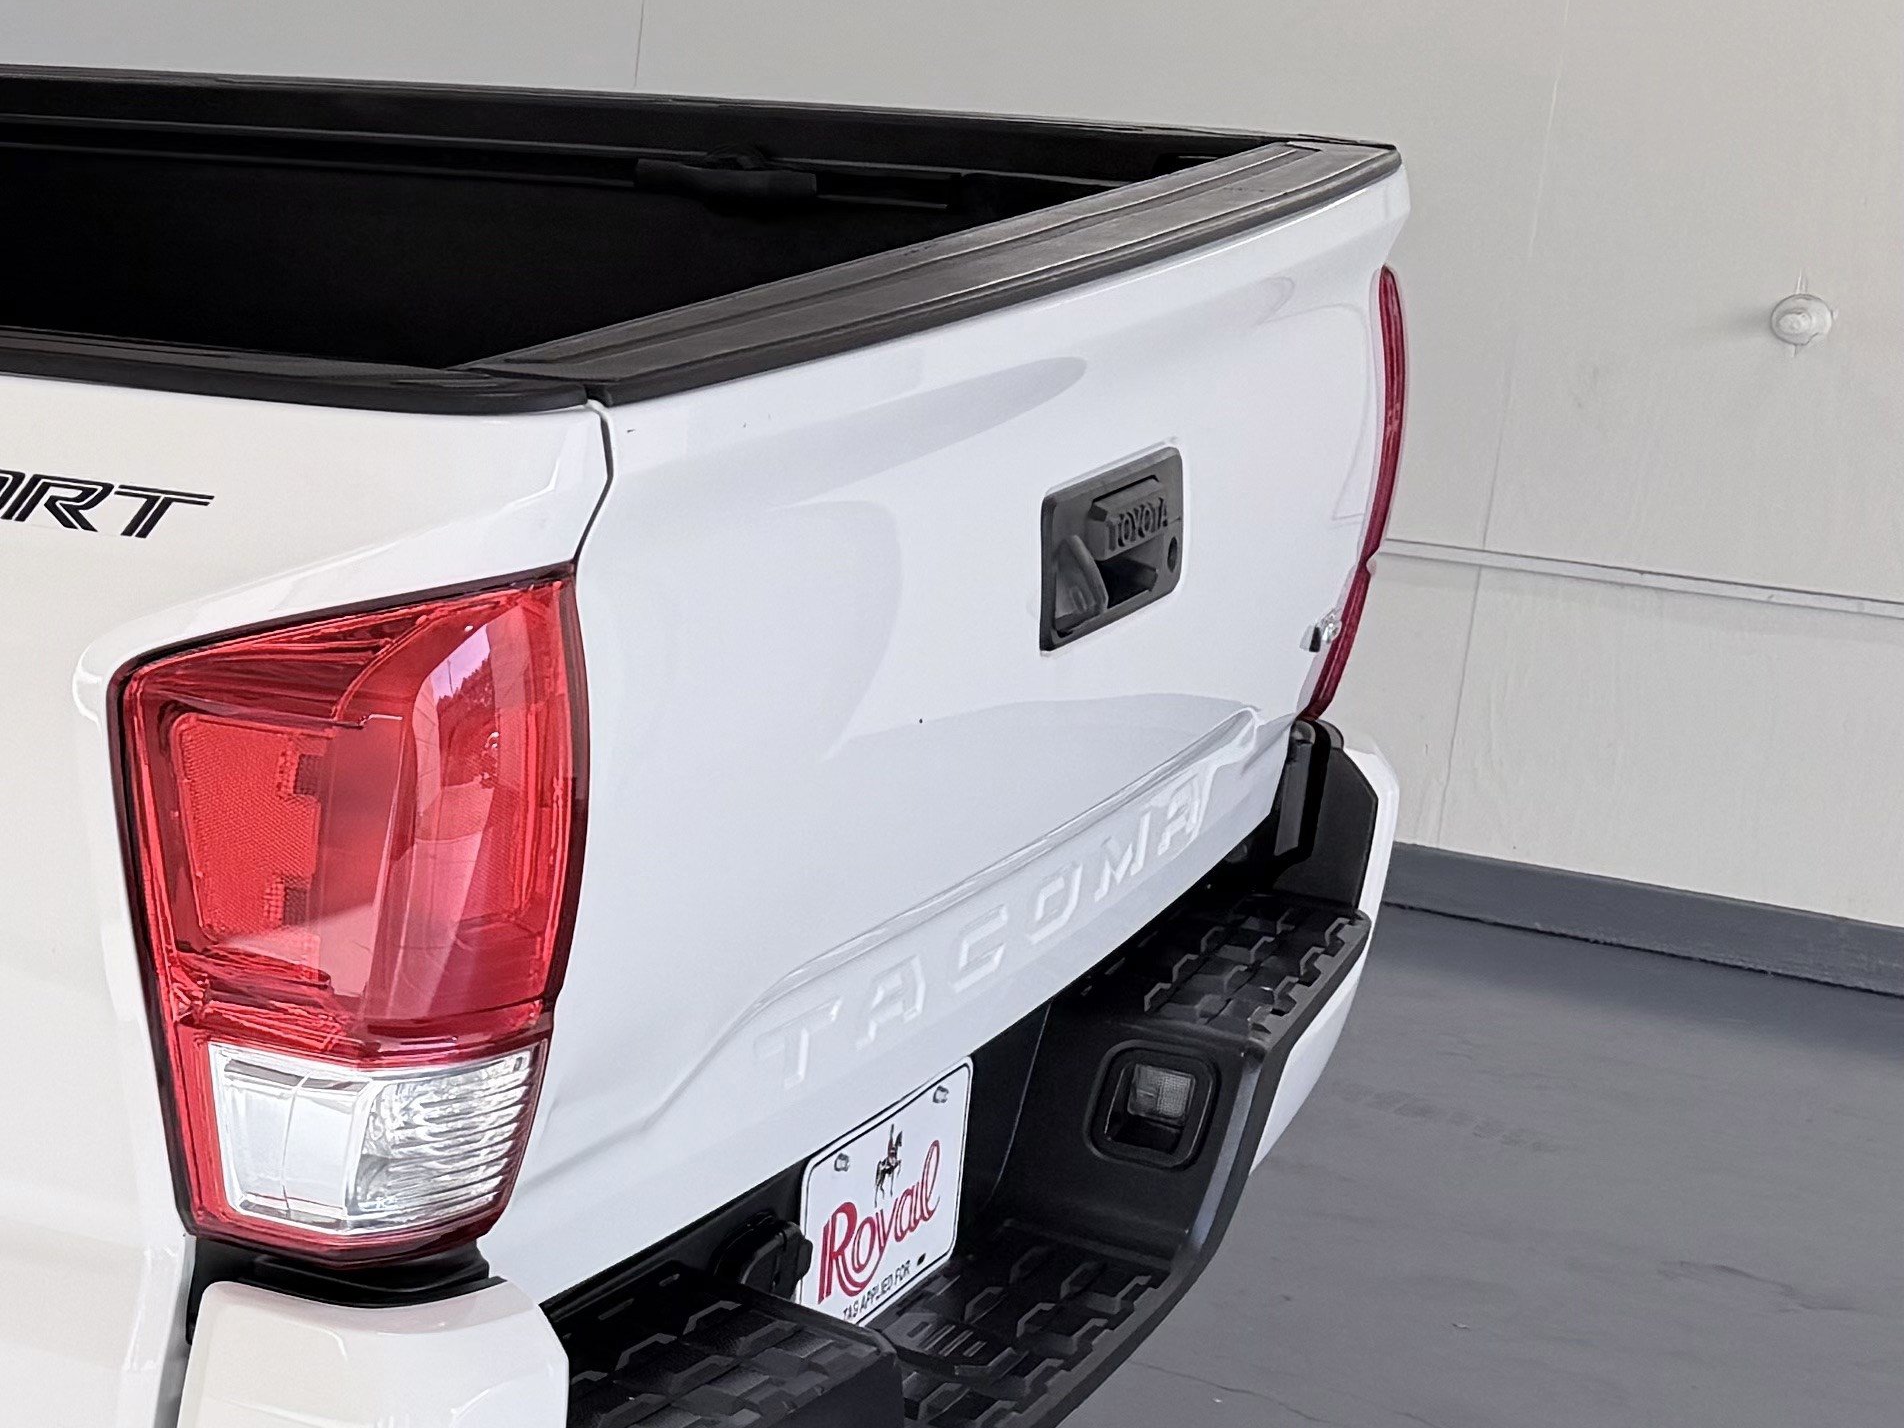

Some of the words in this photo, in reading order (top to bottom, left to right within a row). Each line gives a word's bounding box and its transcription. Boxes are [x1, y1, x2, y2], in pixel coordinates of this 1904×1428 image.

[1106, 496, 1169, 552] TOYOTA
[754, 762, 1215, 1089] TACOMA
[818, 1139, 941, 1305] Royal
[860, 1273, 894, 1313] APPLIED
[894, 1259, 911, 1286] FOR
